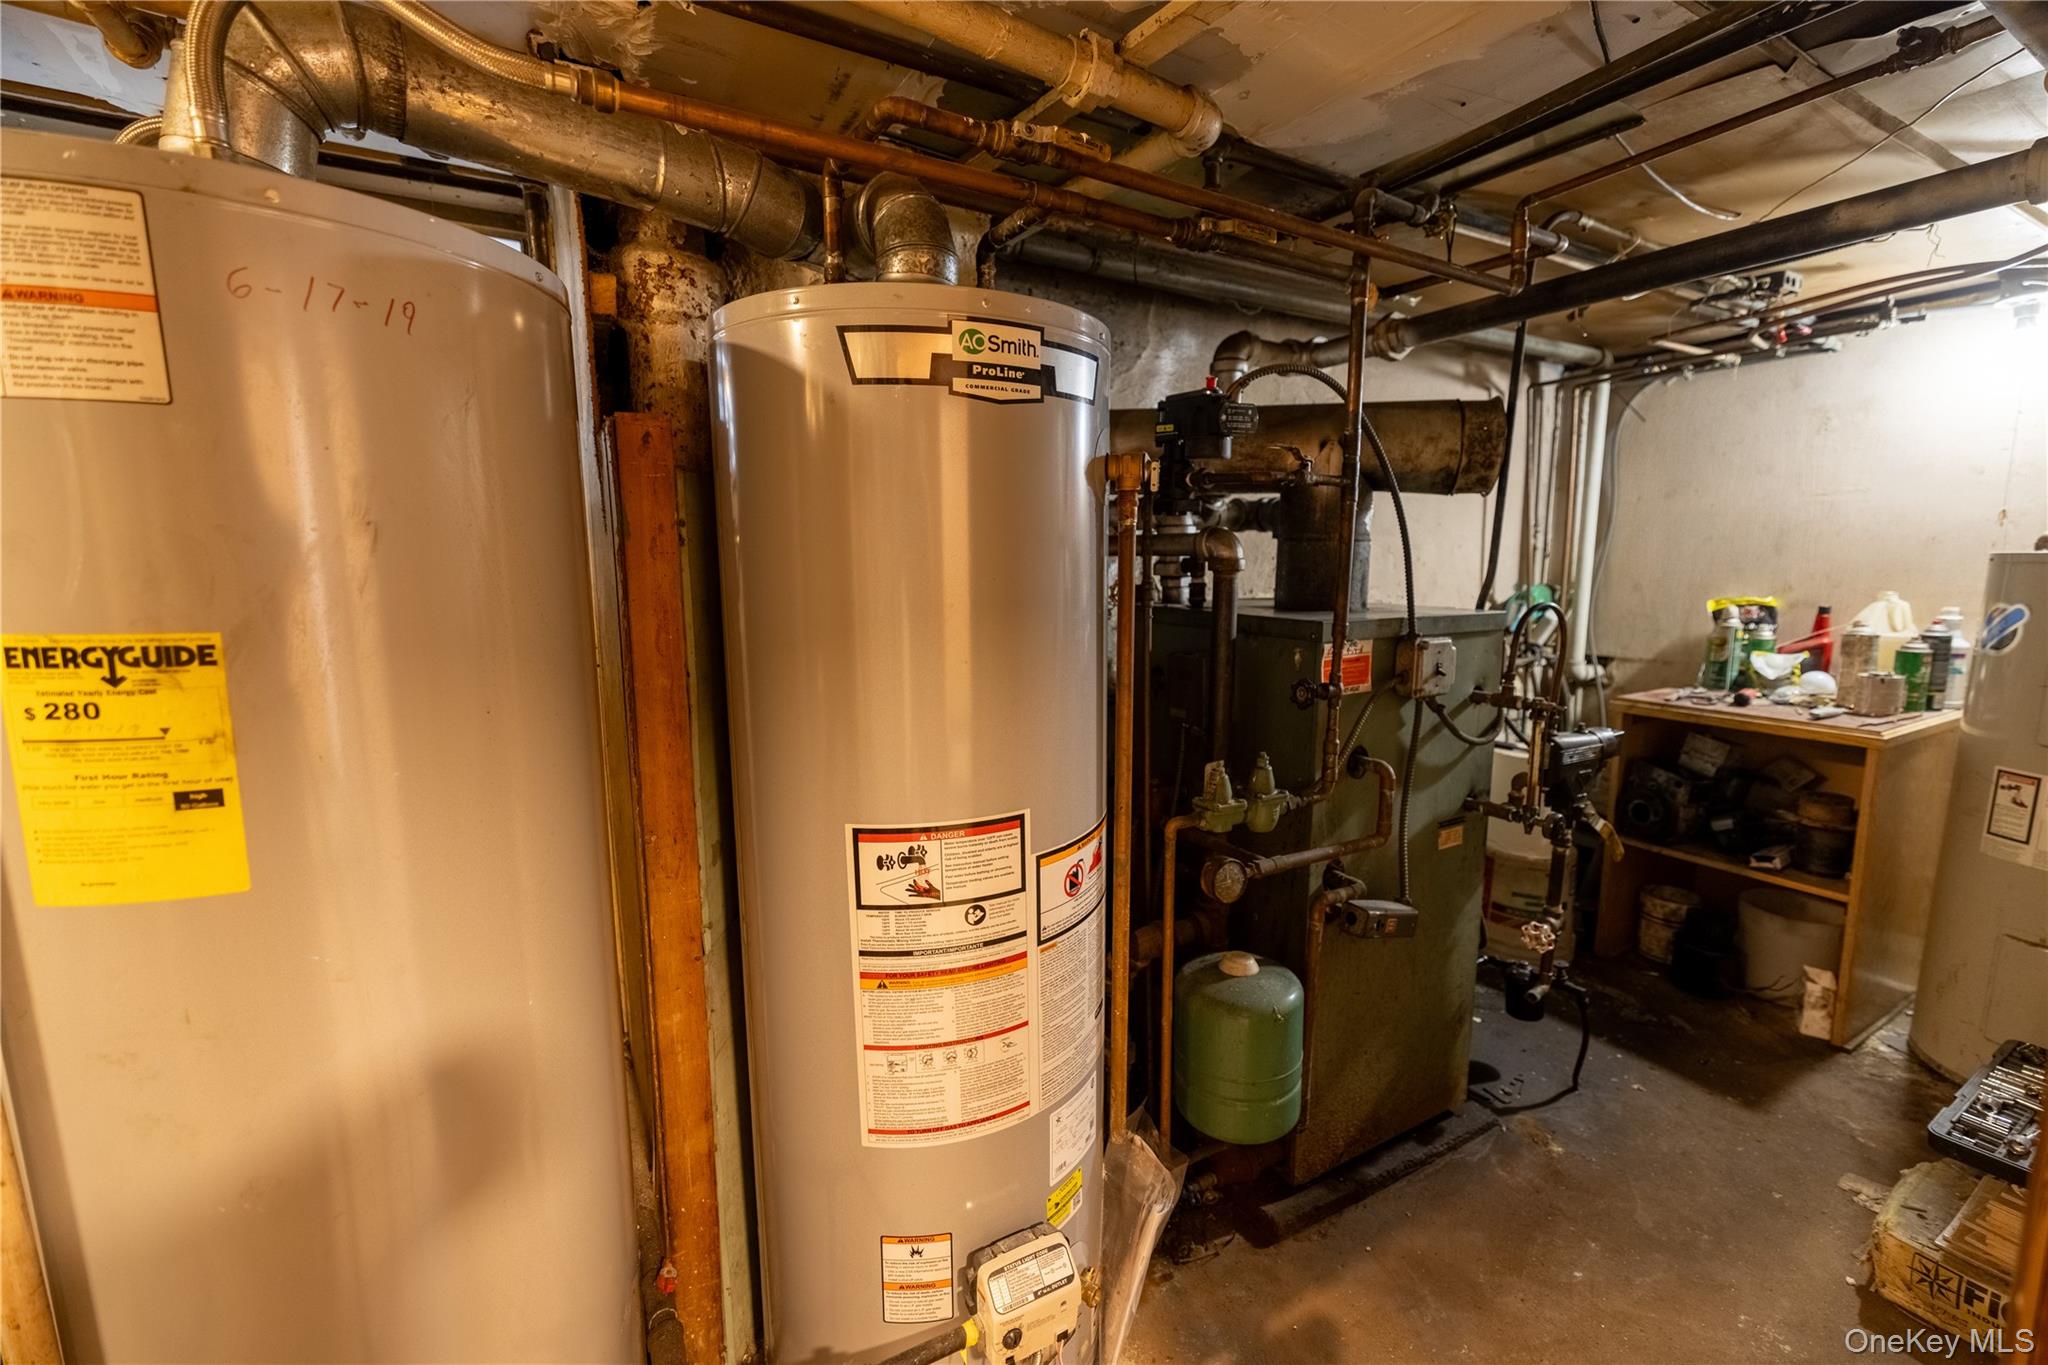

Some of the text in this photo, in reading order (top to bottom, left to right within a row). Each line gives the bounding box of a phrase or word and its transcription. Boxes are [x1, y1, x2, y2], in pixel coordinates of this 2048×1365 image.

[15, 289, 84, 303] WARNING
[972, 364, 1024, 380] ProLine
[965, 384, 1031, 395] COMMERCIAL GRADE
[4, 644, 218, 670] ENERGYGUIDE
[24, 702, 101, 721] $ 280
[132, 771, 169, 780] Rating
[930, 830, 966, 840] DANGER
[905, 1282, 937, 1290] WARNING
